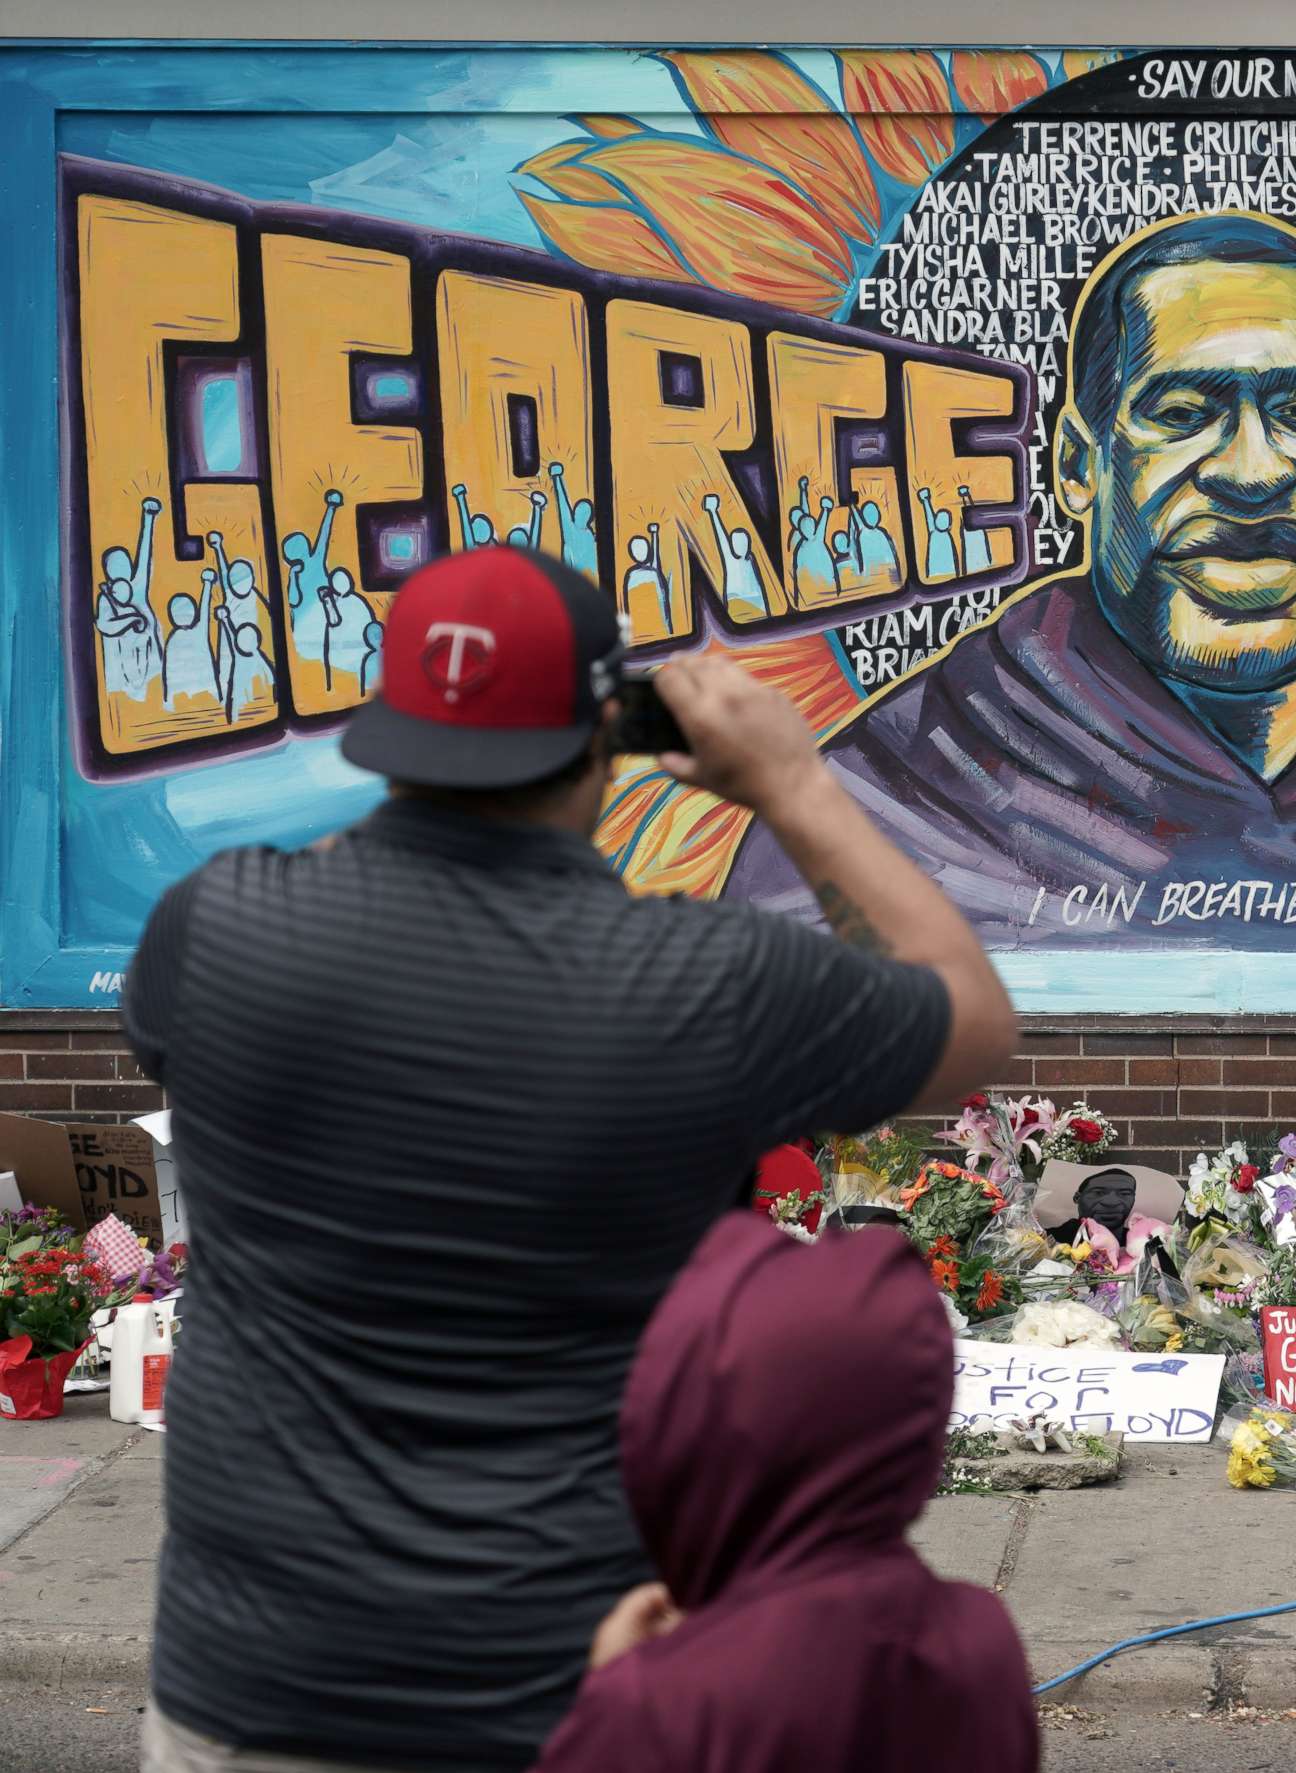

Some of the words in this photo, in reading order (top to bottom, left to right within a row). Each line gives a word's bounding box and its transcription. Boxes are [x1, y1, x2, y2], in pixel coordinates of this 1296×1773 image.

[1139, 60, 1204, 98] SAY
[1211, 59, 1283, 98] OUR
[1013, 121, 1175, 156] TERRENCE
[974, 153, 1074, 185] TAMIR
[1076, 154, 1154, 186] RICE
[916, 182, 982, 213] AKAI
[990, 183, 1083, 215] GURLEY
[1087, 183, 1200, 215] KENDRA
[904, 214, 1035, 246] MICHAEL
[880, 243, 986, 280] TYISHA
[1000, 244, 1097, 280] MILLE
[859, 278, 927, 311] ERIC
[931, 278, 1066, 313] GARNER
[881, 308, 1006, 343] SANDRA
[1013, 310, 1068, 343] BLA
[76, 190, 1017, 757] GEORGE
[1028, 886, 1046, 926] I
[1061, 881, 1147, 928] CAN
